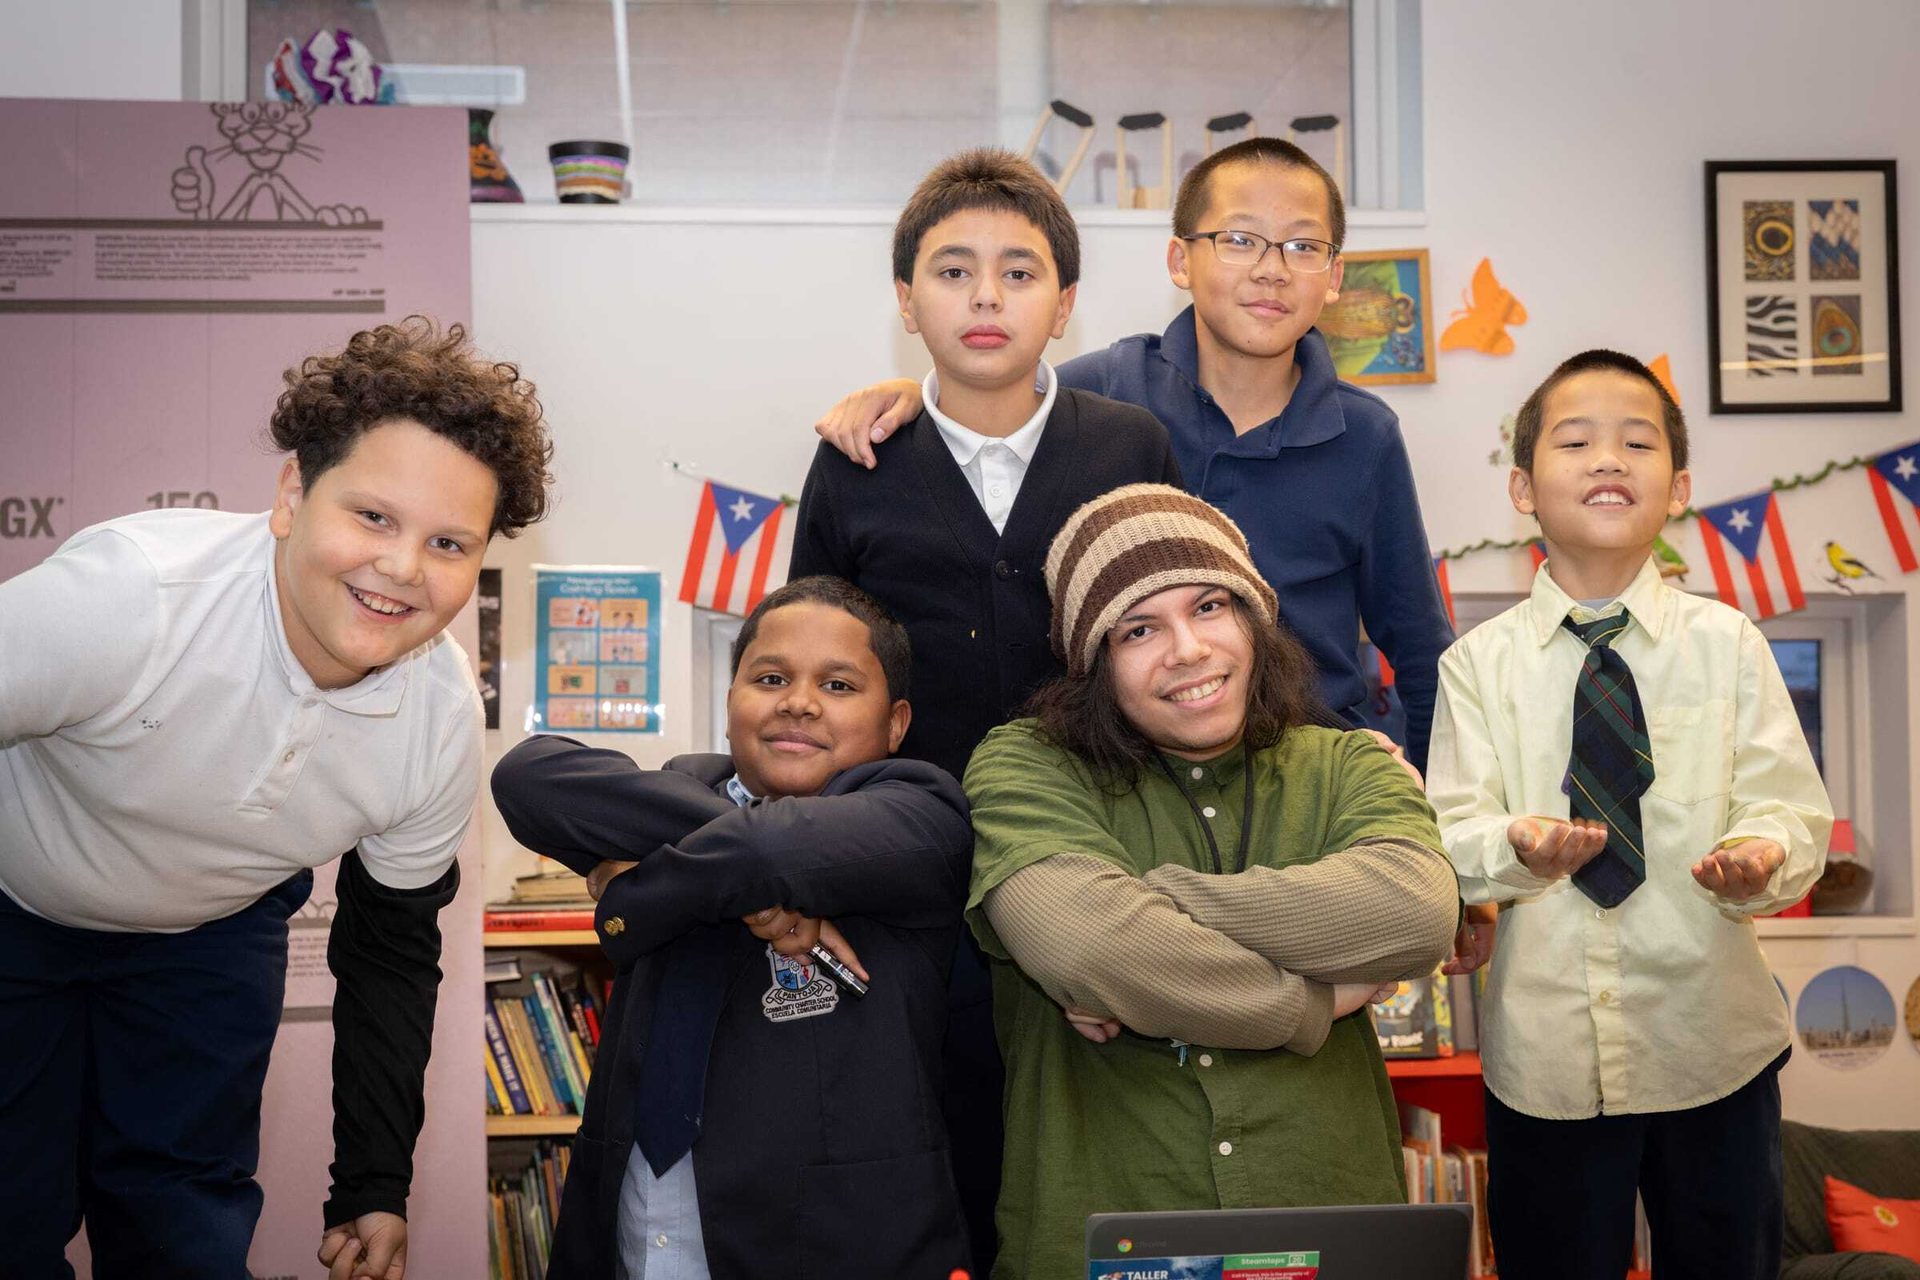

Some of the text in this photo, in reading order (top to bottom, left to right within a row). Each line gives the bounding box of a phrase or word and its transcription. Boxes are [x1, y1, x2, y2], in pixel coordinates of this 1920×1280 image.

[783, 985, 817, 999] PANTOJA
[766, 996, 837, 1013] COMMUNITY CHARTER SCHOOL
[772, 1003, 832, 1018] ESCUELA COMUNITARIA
[1127, 1270, 1168, 1280] TALLER
